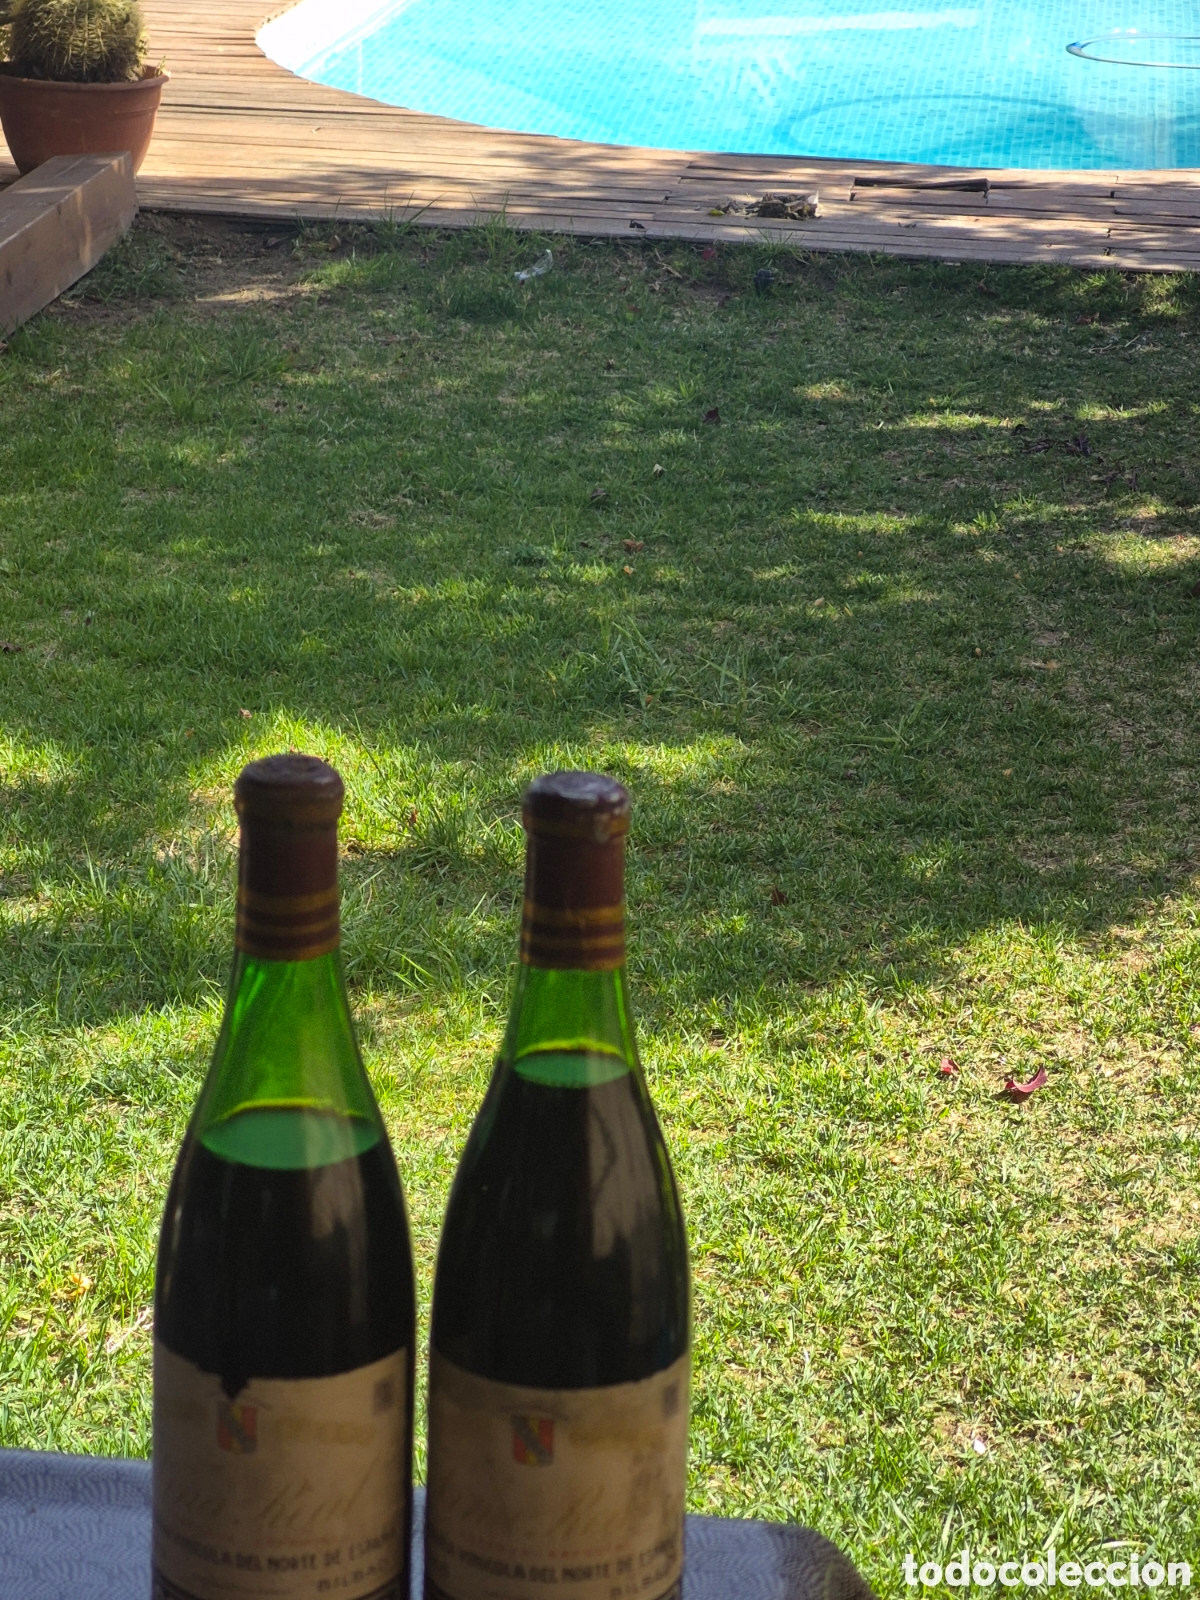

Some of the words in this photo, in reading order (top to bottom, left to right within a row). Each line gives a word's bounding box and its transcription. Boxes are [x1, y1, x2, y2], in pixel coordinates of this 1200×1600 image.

[267, 1552, 317, 1573] NORTE
[323, 1549, 341, 1568] DE
[561, 1561, 610, 1584] NORTE
